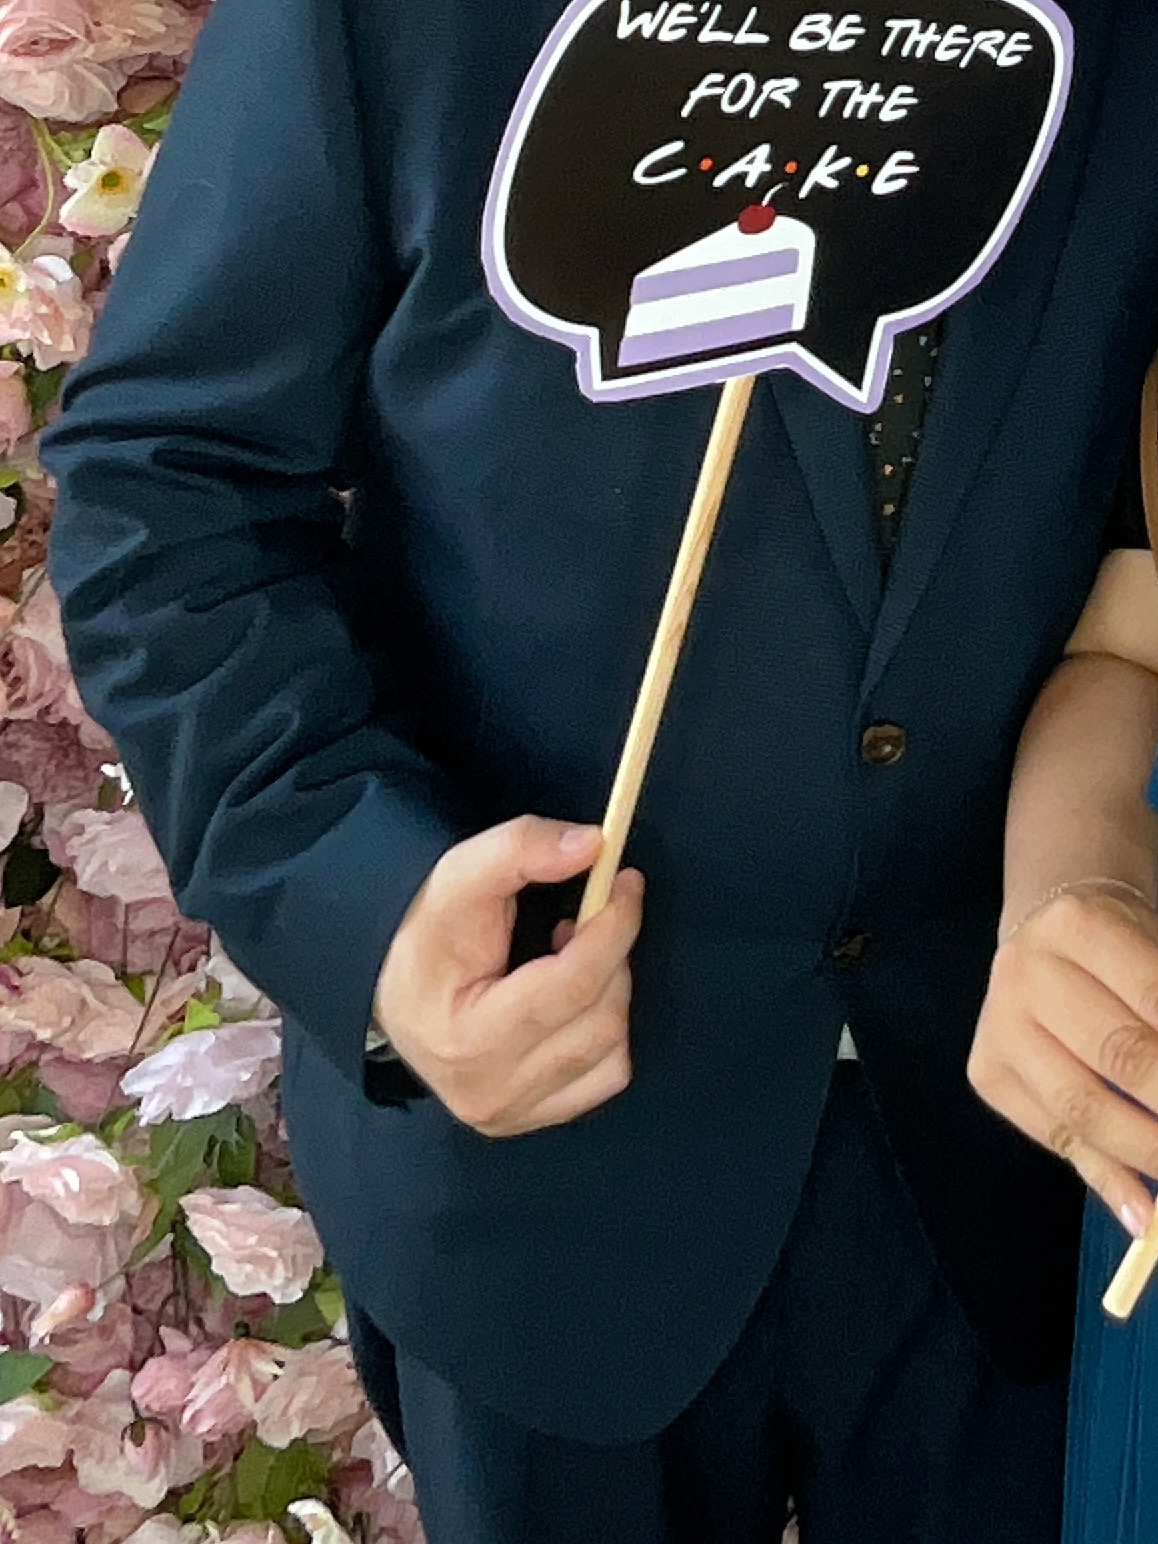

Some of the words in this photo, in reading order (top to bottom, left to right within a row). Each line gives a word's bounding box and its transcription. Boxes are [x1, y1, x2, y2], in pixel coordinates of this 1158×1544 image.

[787, 11, 867, 53] BE
[879, 17, 1035, 69] THERE
[680, 71, 801, 119] FOR
[818, 78, 920, 123] THE
